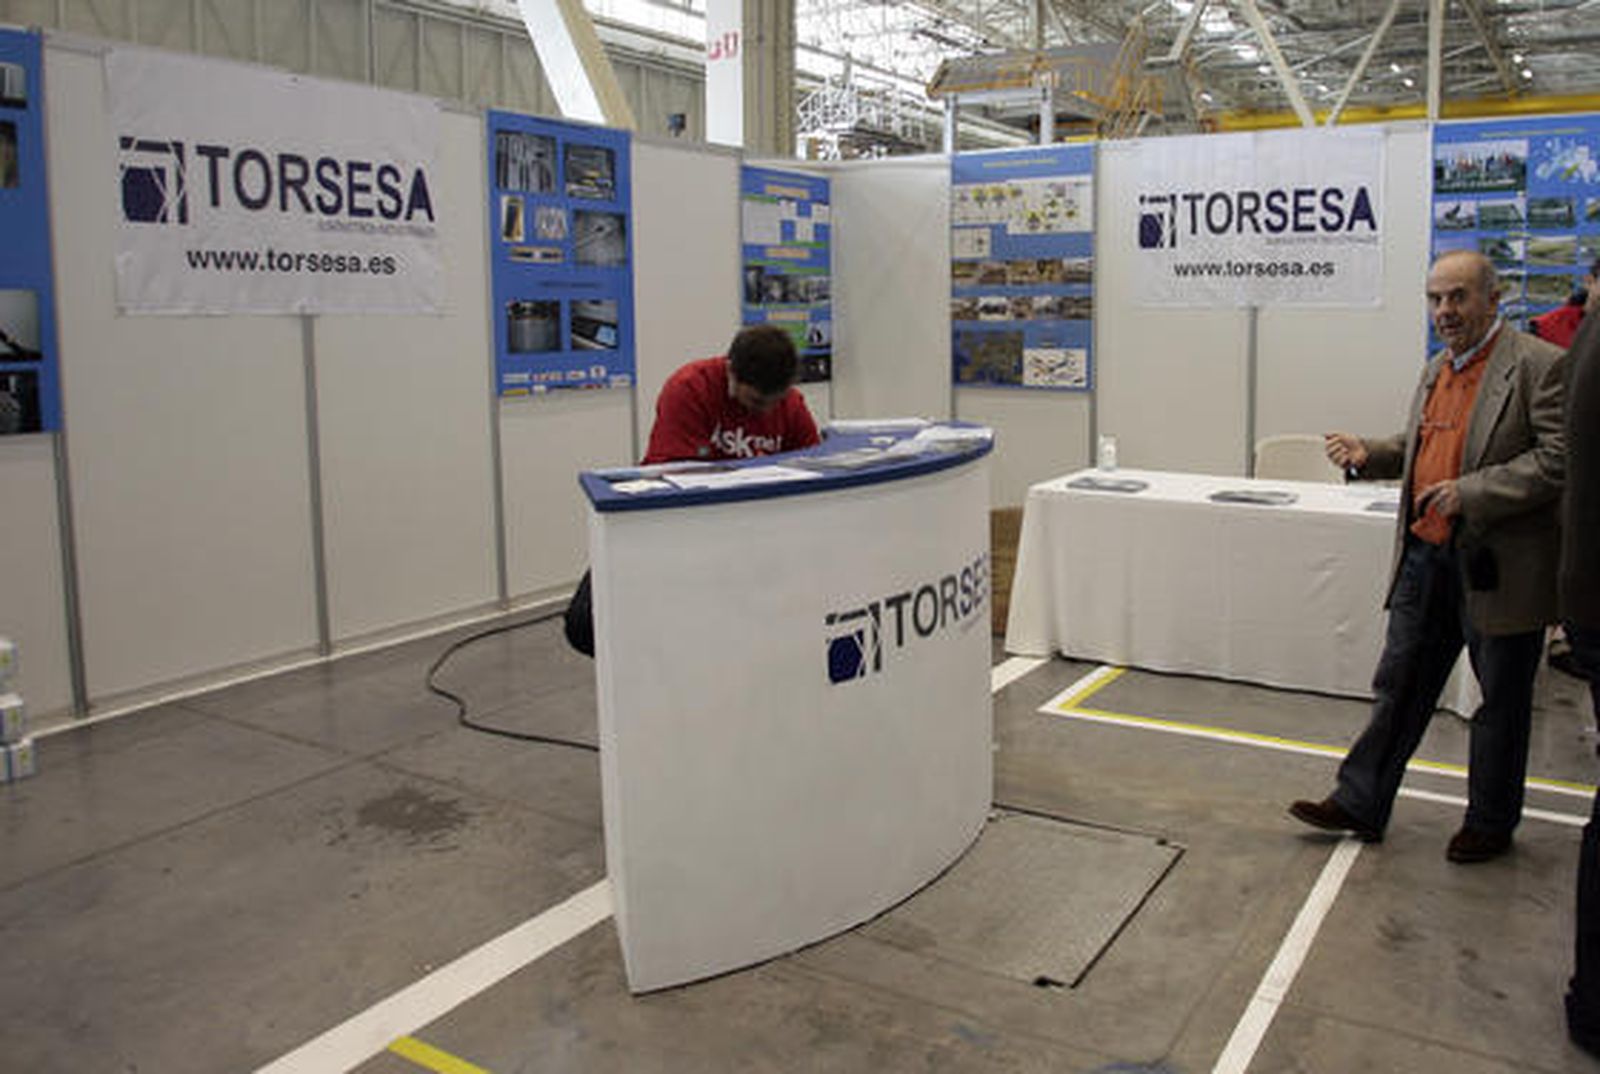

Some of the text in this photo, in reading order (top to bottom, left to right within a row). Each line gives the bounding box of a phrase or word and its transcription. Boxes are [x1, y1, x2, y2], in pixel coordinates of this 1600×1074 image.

[195, 144, 435, 222] TORSESA
[1182, 186, 1377, 235] TORSESA
[186, 247, 396, 275] www.torsesa.es
[1173, 260, 1335, 277] www.torsesa.es
[885, 552, 986, 648] TORSE
